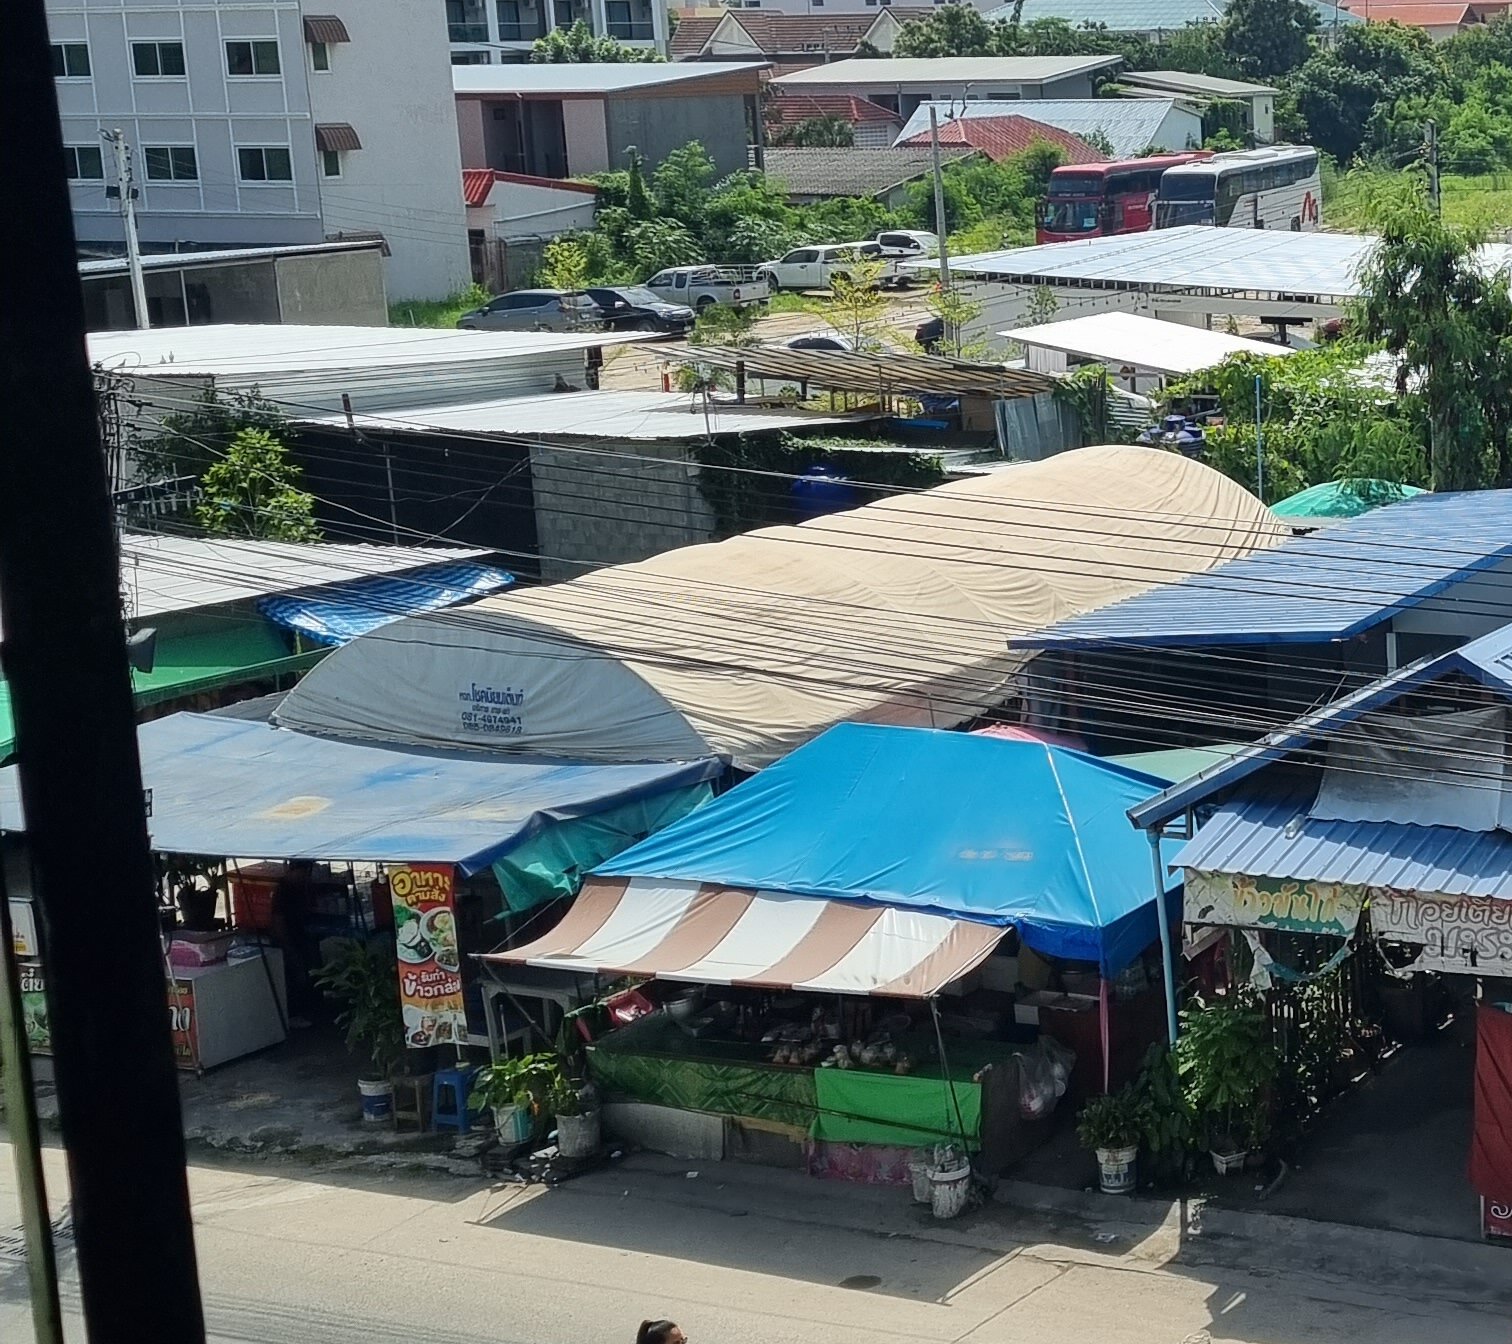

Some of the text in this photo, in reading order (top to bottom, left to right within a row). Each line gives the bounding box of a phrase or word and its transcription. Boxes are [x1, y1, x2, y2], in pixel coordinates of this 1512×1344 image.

[392, 870, 451, 898] อาหาร
[406, 886, 446, 907] ตามสั่ง
